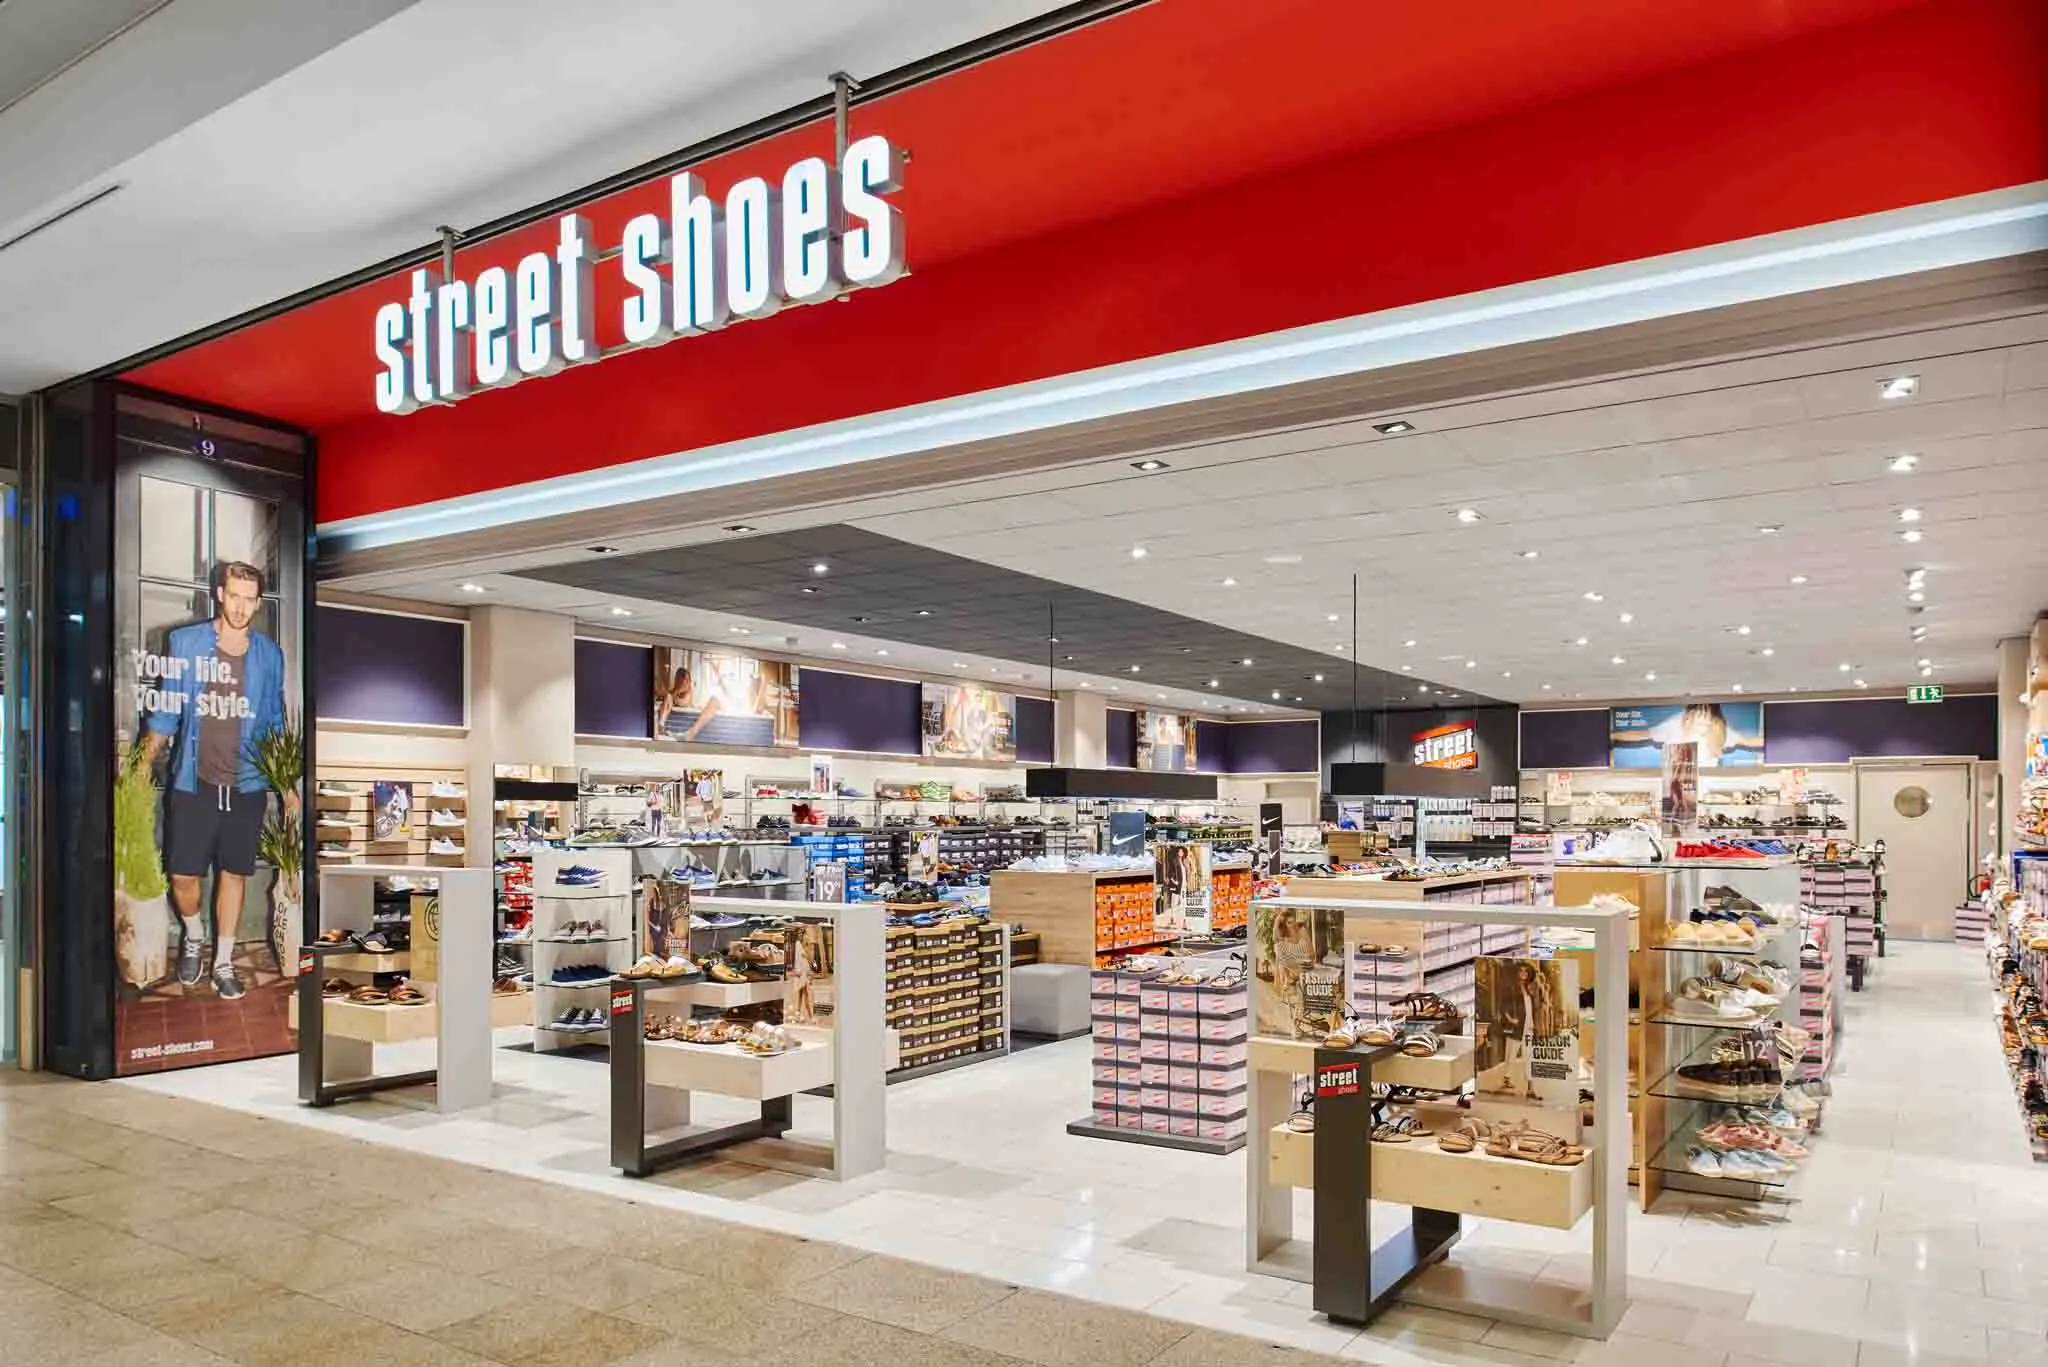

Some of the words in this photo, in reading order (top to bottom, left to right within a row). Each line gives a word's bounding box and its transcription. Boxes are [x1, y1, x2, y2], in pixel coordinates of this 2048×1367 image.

[375, 213, 586, 415] street
[622, 135, 893, 346] shoes
[201, 439, 215, 456] 9
[134, 649, 189, 680] Your
[194, 655, 238, 685] life.
[133, 684, 189, 716] Your
[194, 690, 256, 720] style.
[1414, 728, 1474, 766] street
[1443, 756, 1473, 769] shoes
[1299, 972, 1340, 986] FASHION
[1306, 984, 1334, 997] GUIDE
[1525, 1035, 1572, 1048] FASHION
[1533, 1047, 1566, 1061] GUIDE
[1319, 1067, 1358, 1088] street
